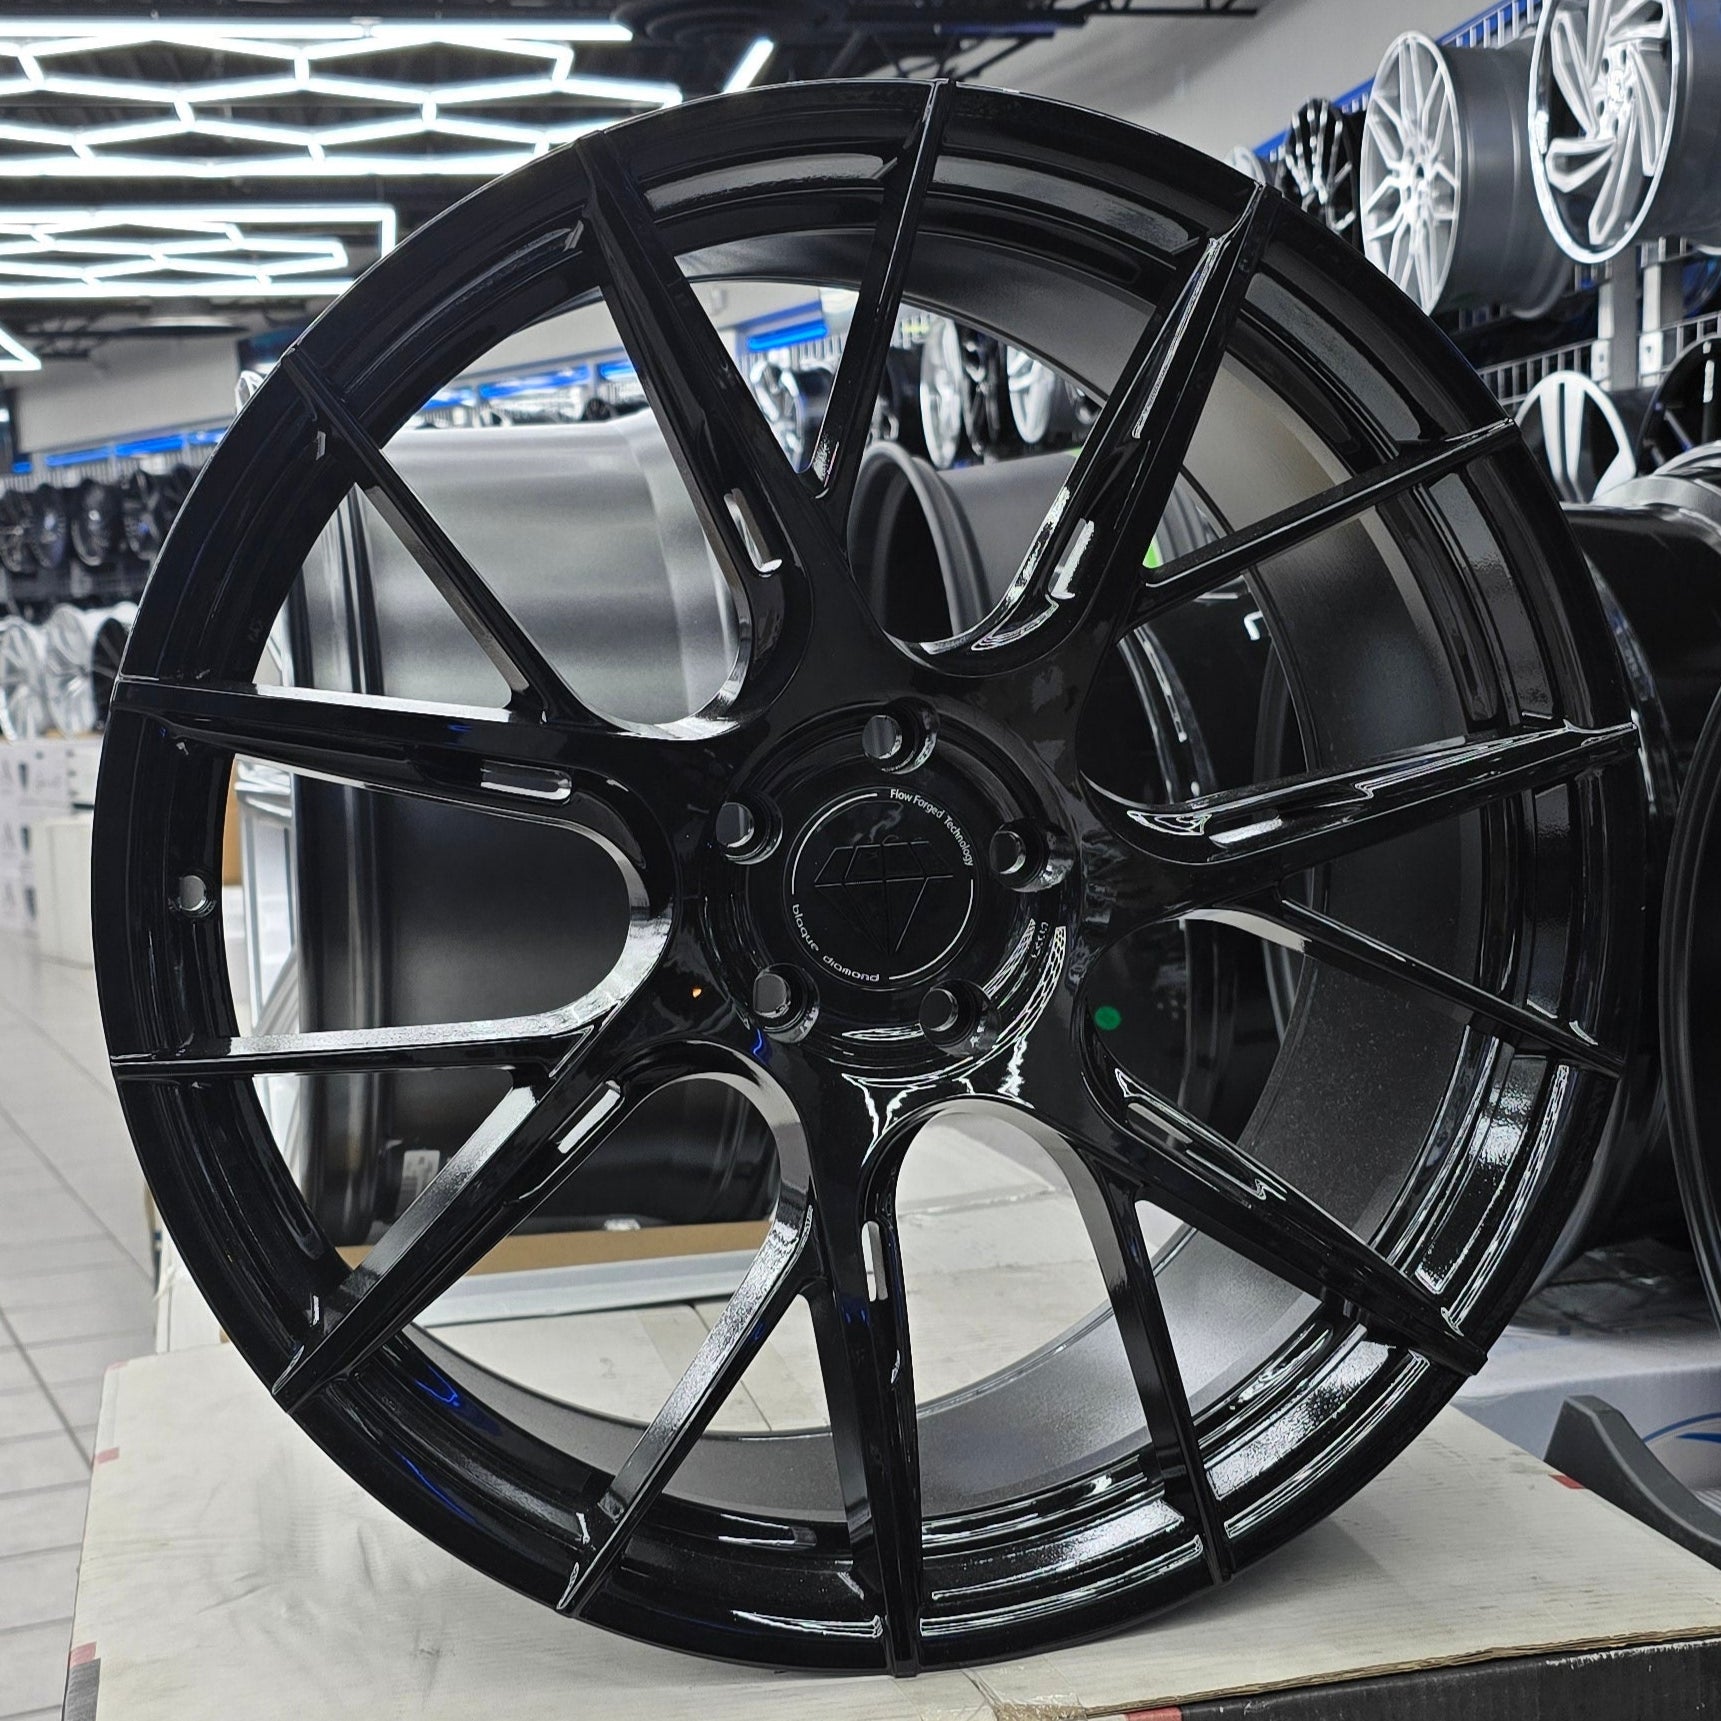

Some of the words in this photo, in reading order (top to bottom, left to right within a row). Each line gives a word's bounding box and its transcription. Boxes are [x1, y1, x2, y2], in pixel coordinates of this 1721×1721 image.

[890, 788, 913, 802] Flow
[913, 795, 945, 819] Forged
[943, 816, 974, 867] Technology
[792, 904, 819, 951] blaque
[823, 955, 880, 982] diamond
